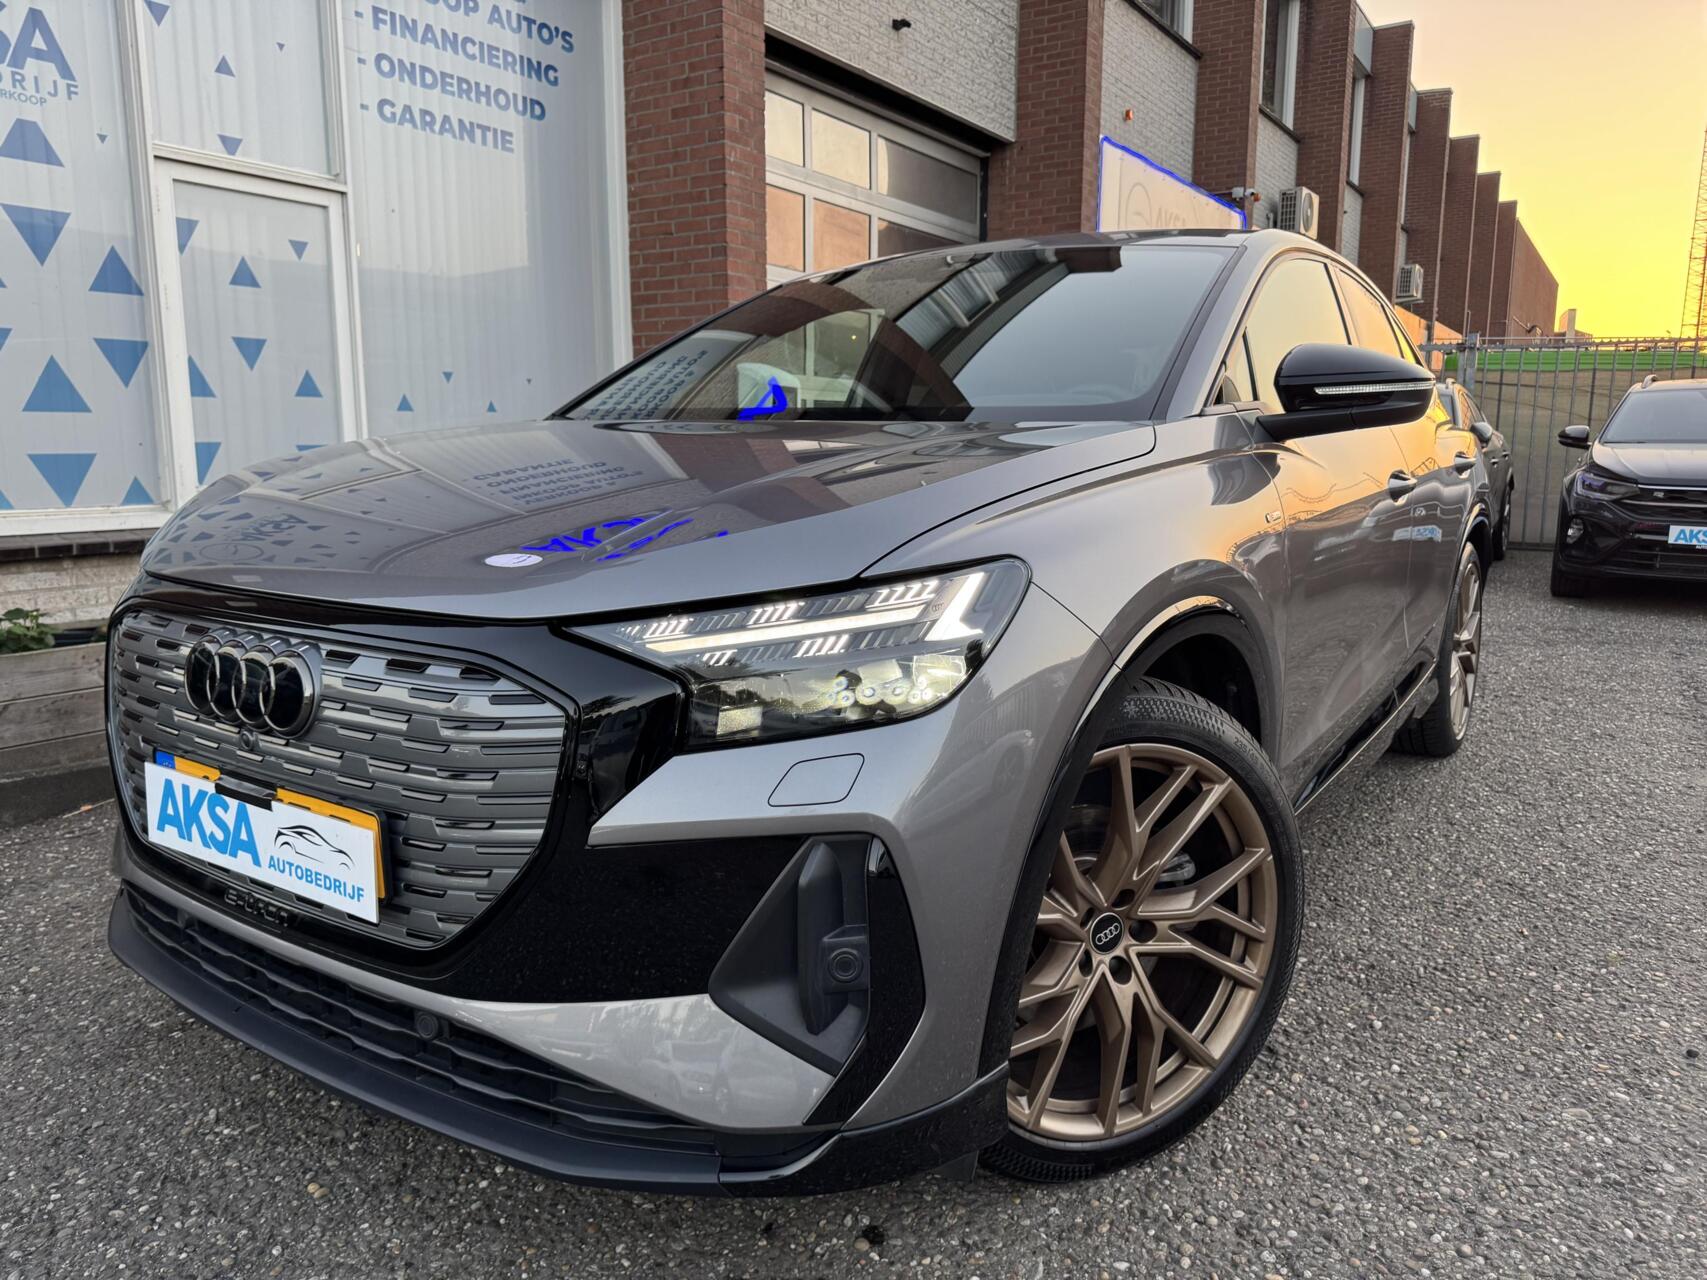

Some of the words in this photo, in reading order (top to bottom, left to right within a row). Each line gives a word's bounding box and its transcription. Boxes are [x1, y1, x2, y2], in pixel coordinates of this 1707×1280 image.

[0, 0, 77, 82] A
[371, 5, 560, 87] FINANCIERING
[487, 4, 575, 54] AUTO'S
[0, 70, 79, 101] RIJF
[374, 53, 547, 121] ONDERHOUD
[377, 98, 515, 153] GARANTIE
[157, 778, 262, 868] AKSA
[268, 855, 365, 903] AUTOBEDRIJF
